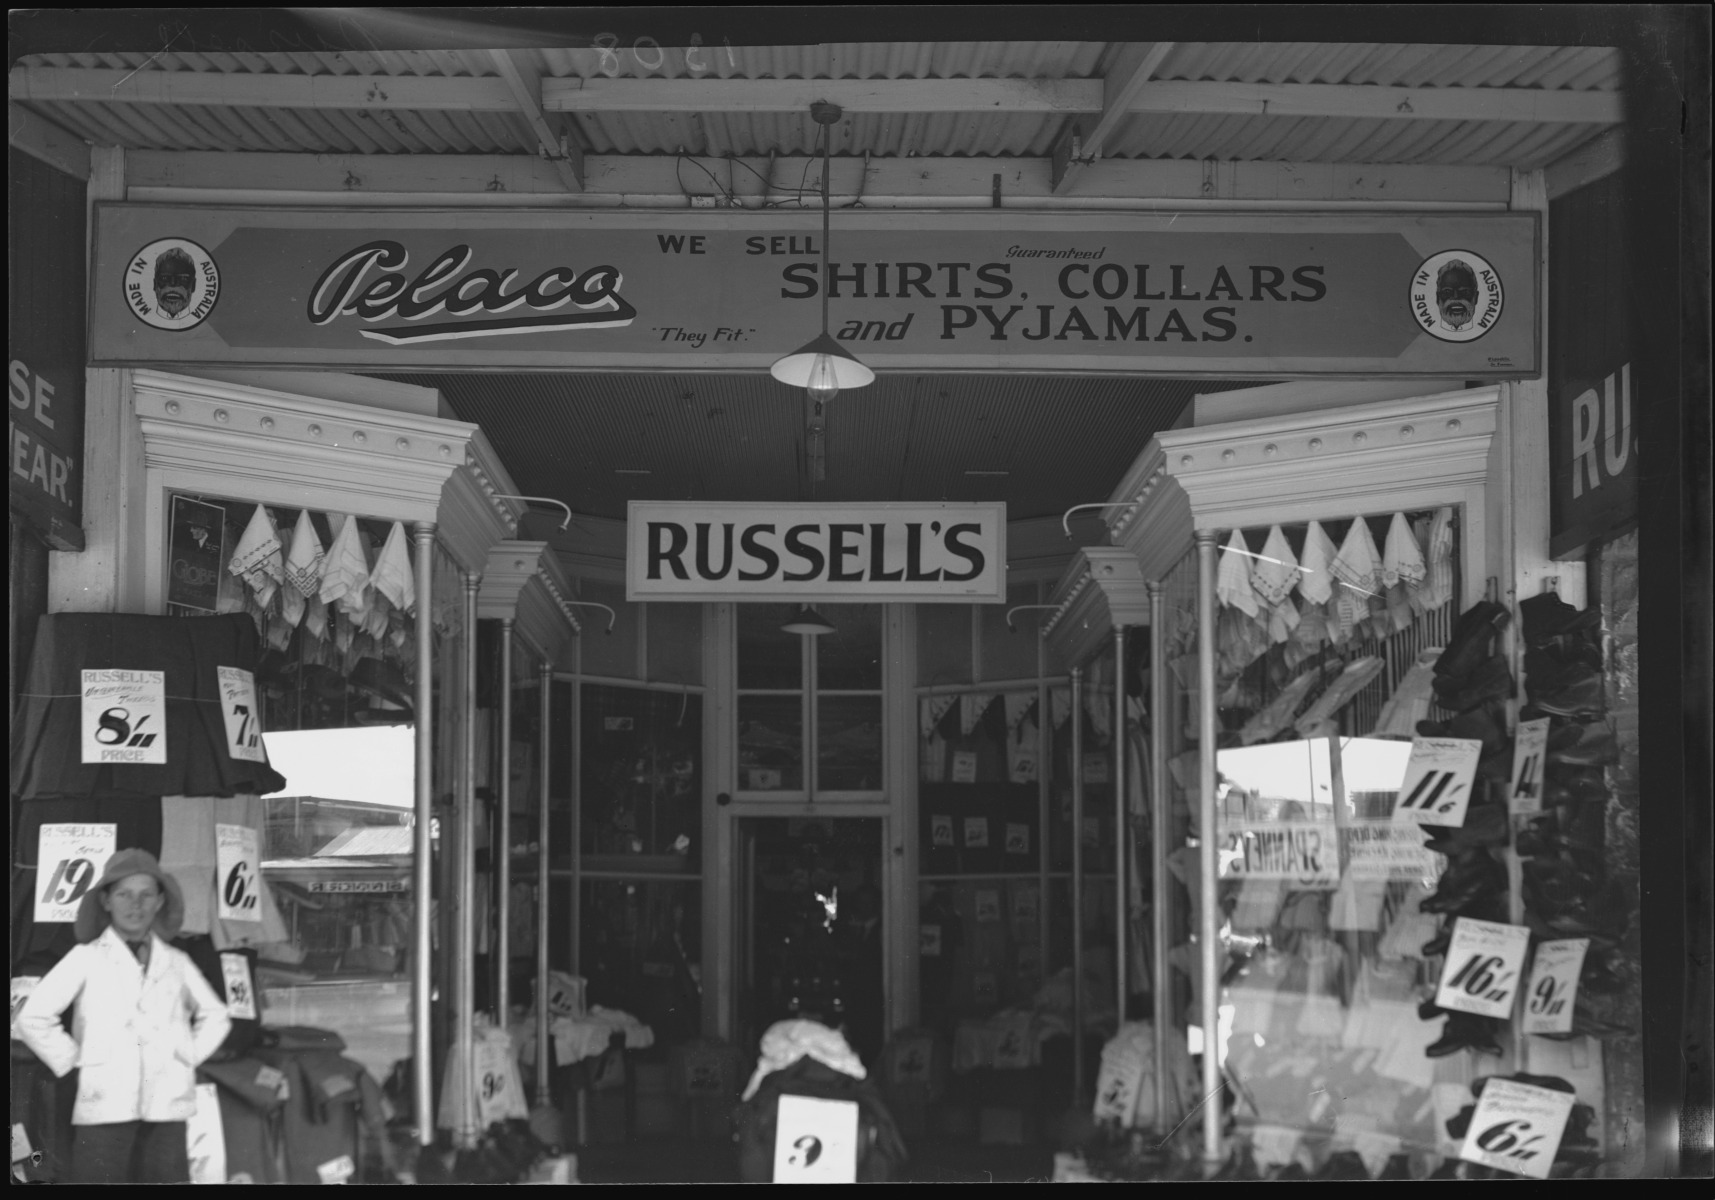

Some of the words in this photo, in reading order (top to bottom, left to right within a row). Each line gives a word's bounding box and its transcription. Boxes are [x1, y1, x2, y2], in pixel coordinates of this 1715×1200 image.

[657, 235, 707, 255] WE
[745, 236, 821, 255] SELL
[1006, 245, 1106, 260] Guaranteed
[132, 257, 148, 274] IN
[781, 262, 1028, 302] SHIRTS,
[1058, 263, 1327, 303] COLLARS
[1416, 270, 1430, 286] IN
[130, 283, 151, 315] MADE
[191, 260, 216, 319] AUSTRALIA
[307, 240, 637, 343] Pelaco
[1478, 269, 1500, 330] AUSTRALIA
[837, 313, 913, 341] and
[940, 305, 1254, 343] PYJAMAS.
[1415, 293, 1436, 328] MADE
[1572, 361, 1638, 499] RU
[646, 521, 985, 582] RUSSELL'S
[84, 671, 162, 684] RUSSELL'S
[101, 750, 145, 761] PRICE
